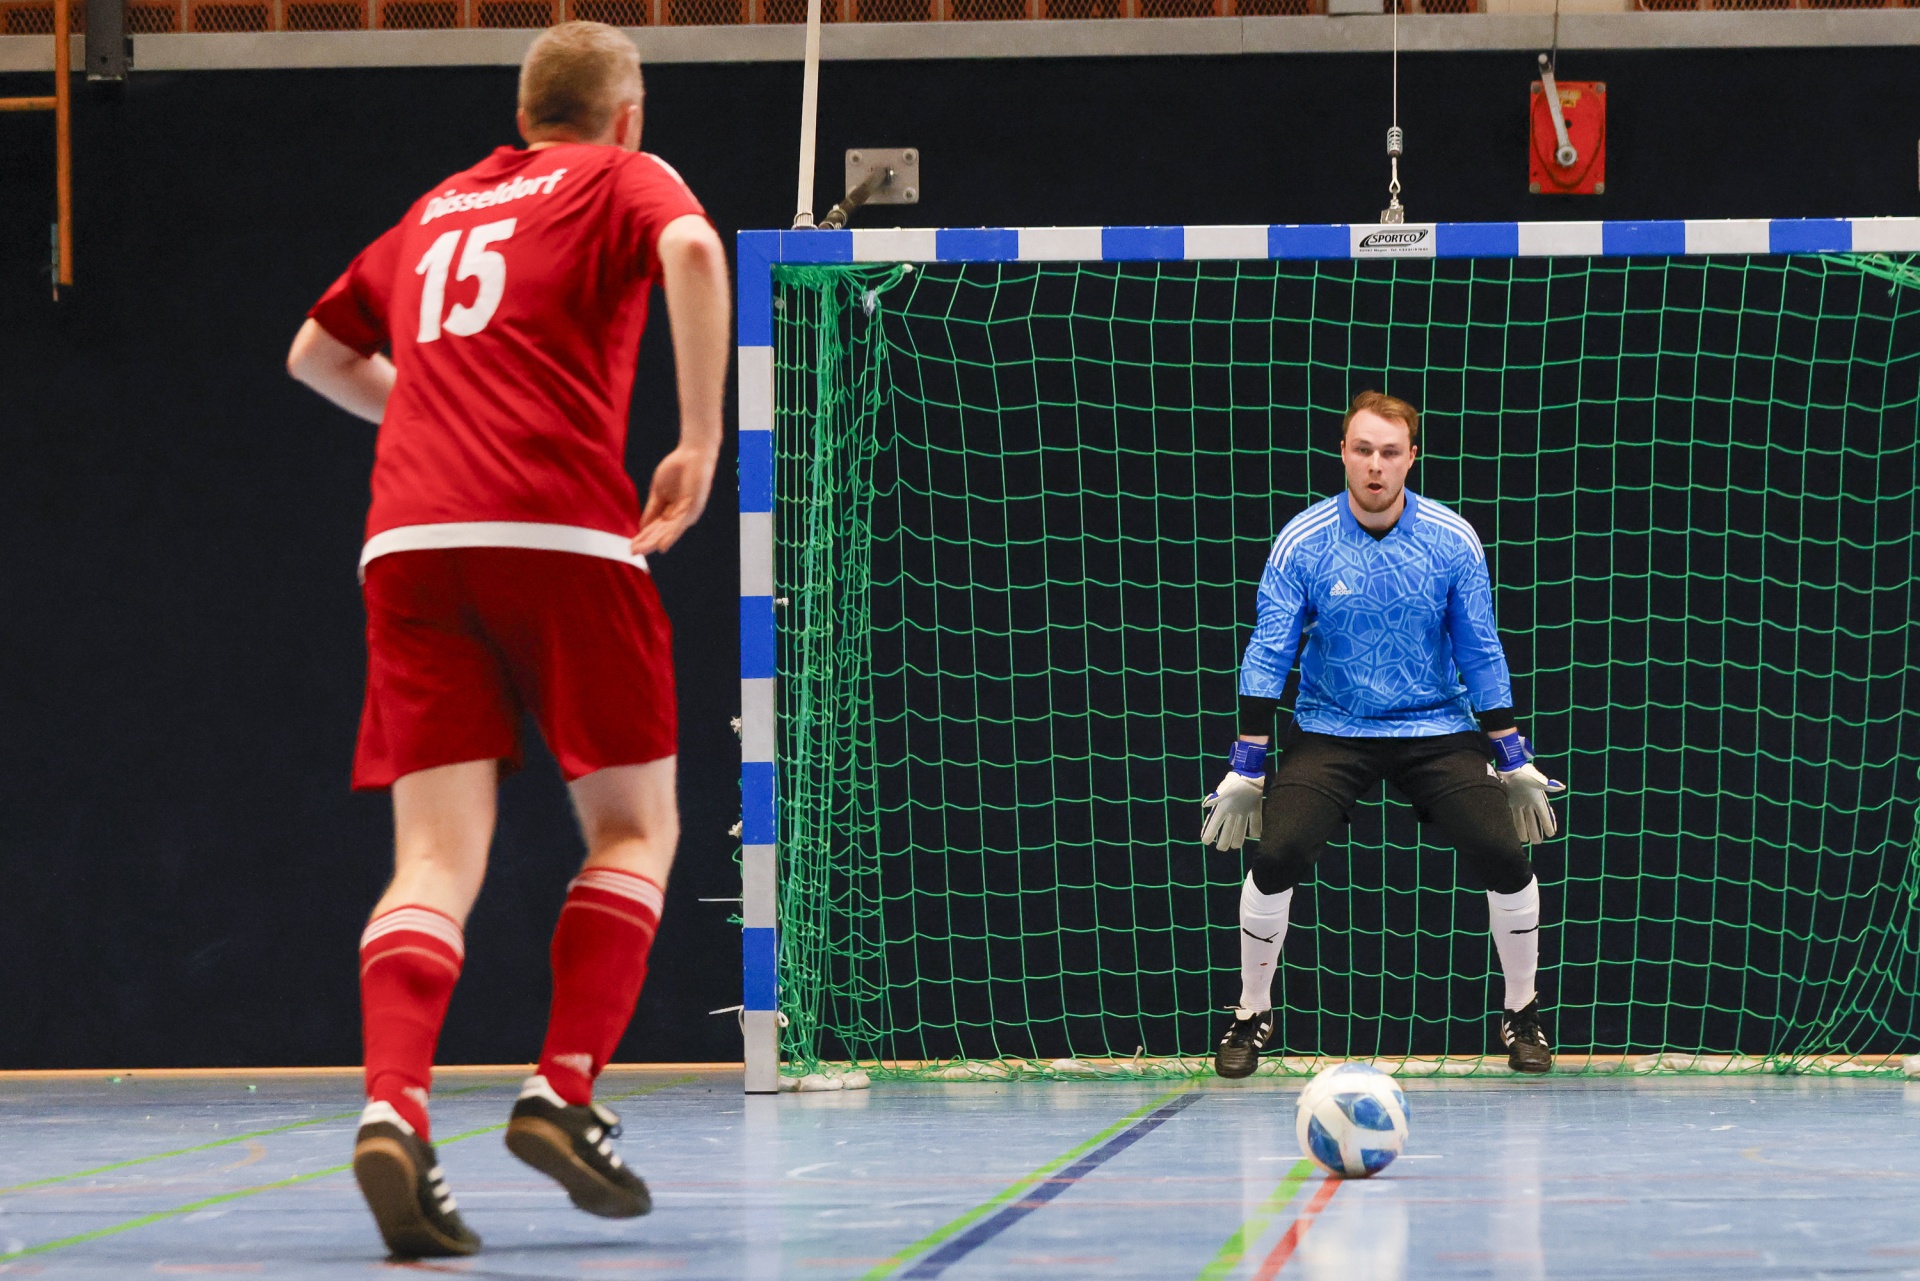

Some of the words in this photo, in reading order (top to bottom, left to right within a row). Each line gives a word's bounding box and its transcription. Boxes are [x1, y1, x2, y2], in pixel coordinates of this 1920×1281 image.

[419, 168, 568, 226] Düsseldorf
[1370, 233, 1417, 243] SPORTCO
[415, 217, 518, 344] 15
[1329, 587, 1352, 596] adidas
